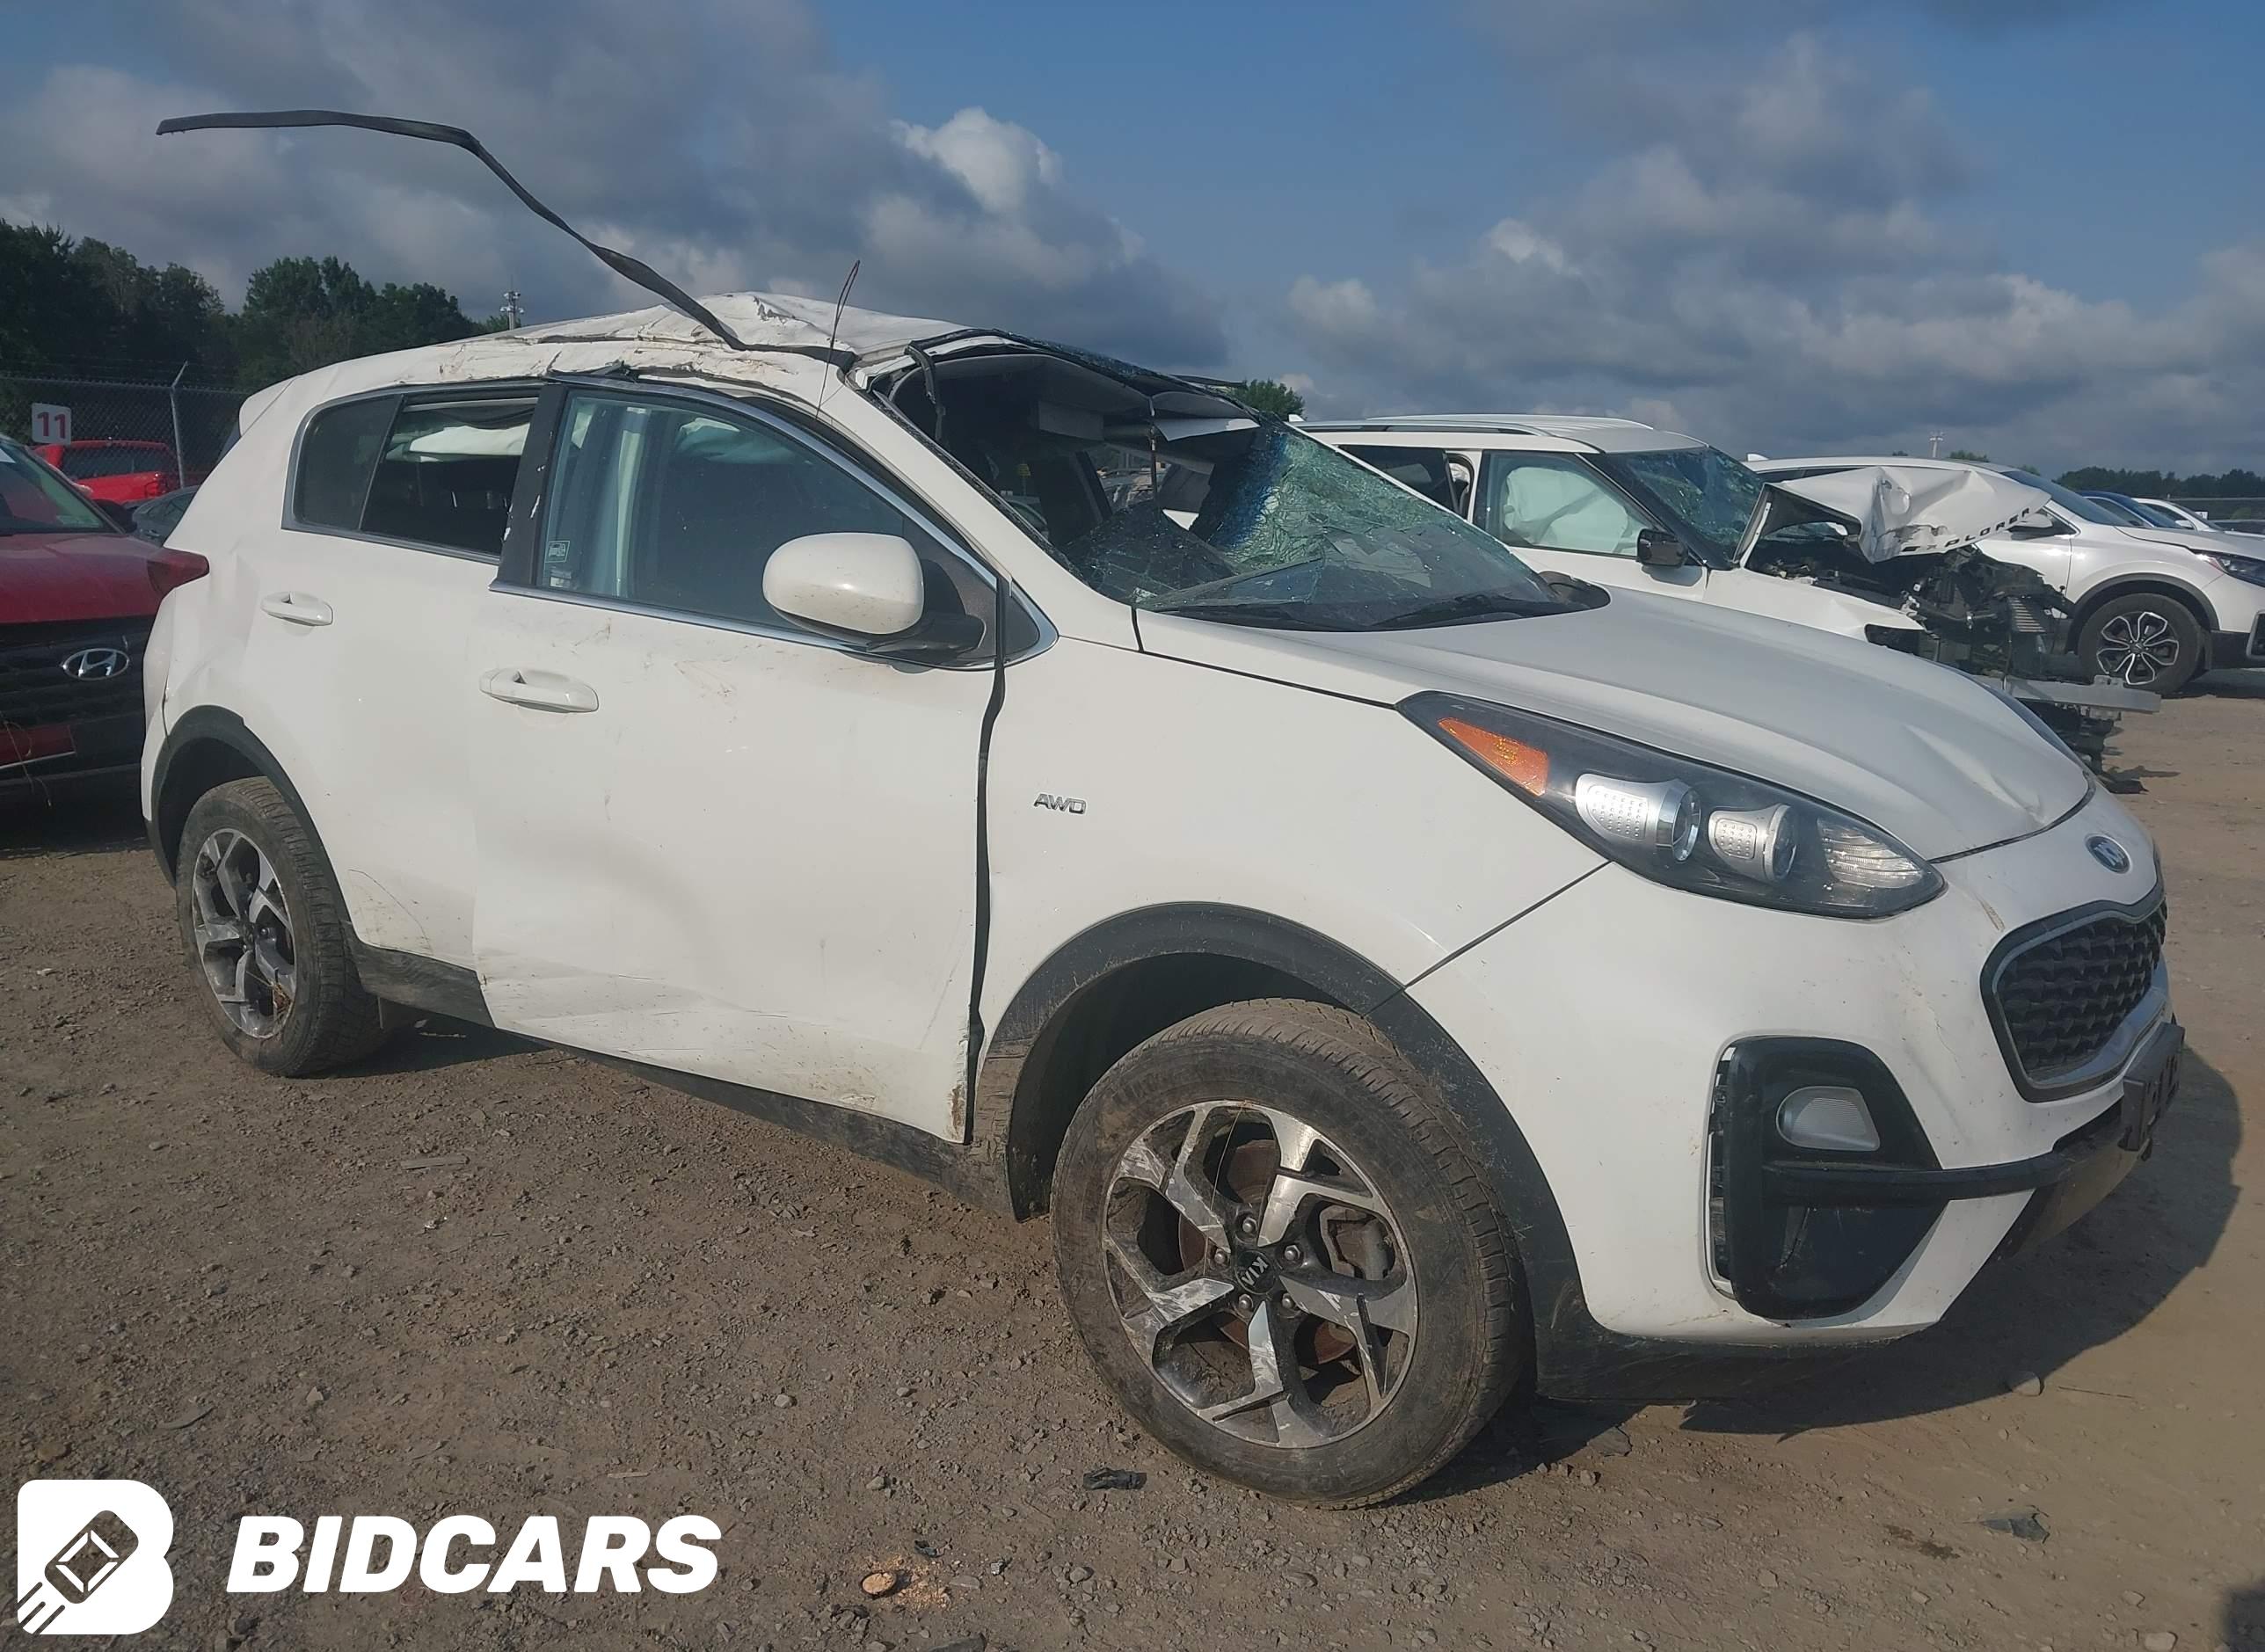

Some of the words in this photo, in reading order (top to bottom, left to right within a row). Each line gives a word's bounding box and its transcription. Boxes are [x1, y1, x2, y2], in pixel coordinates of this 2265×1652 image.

[37, 411, 66, 439] 11
[1033, 793, 1086, 814] AWD
[1241, 1256, 1269, 1285] KIA
